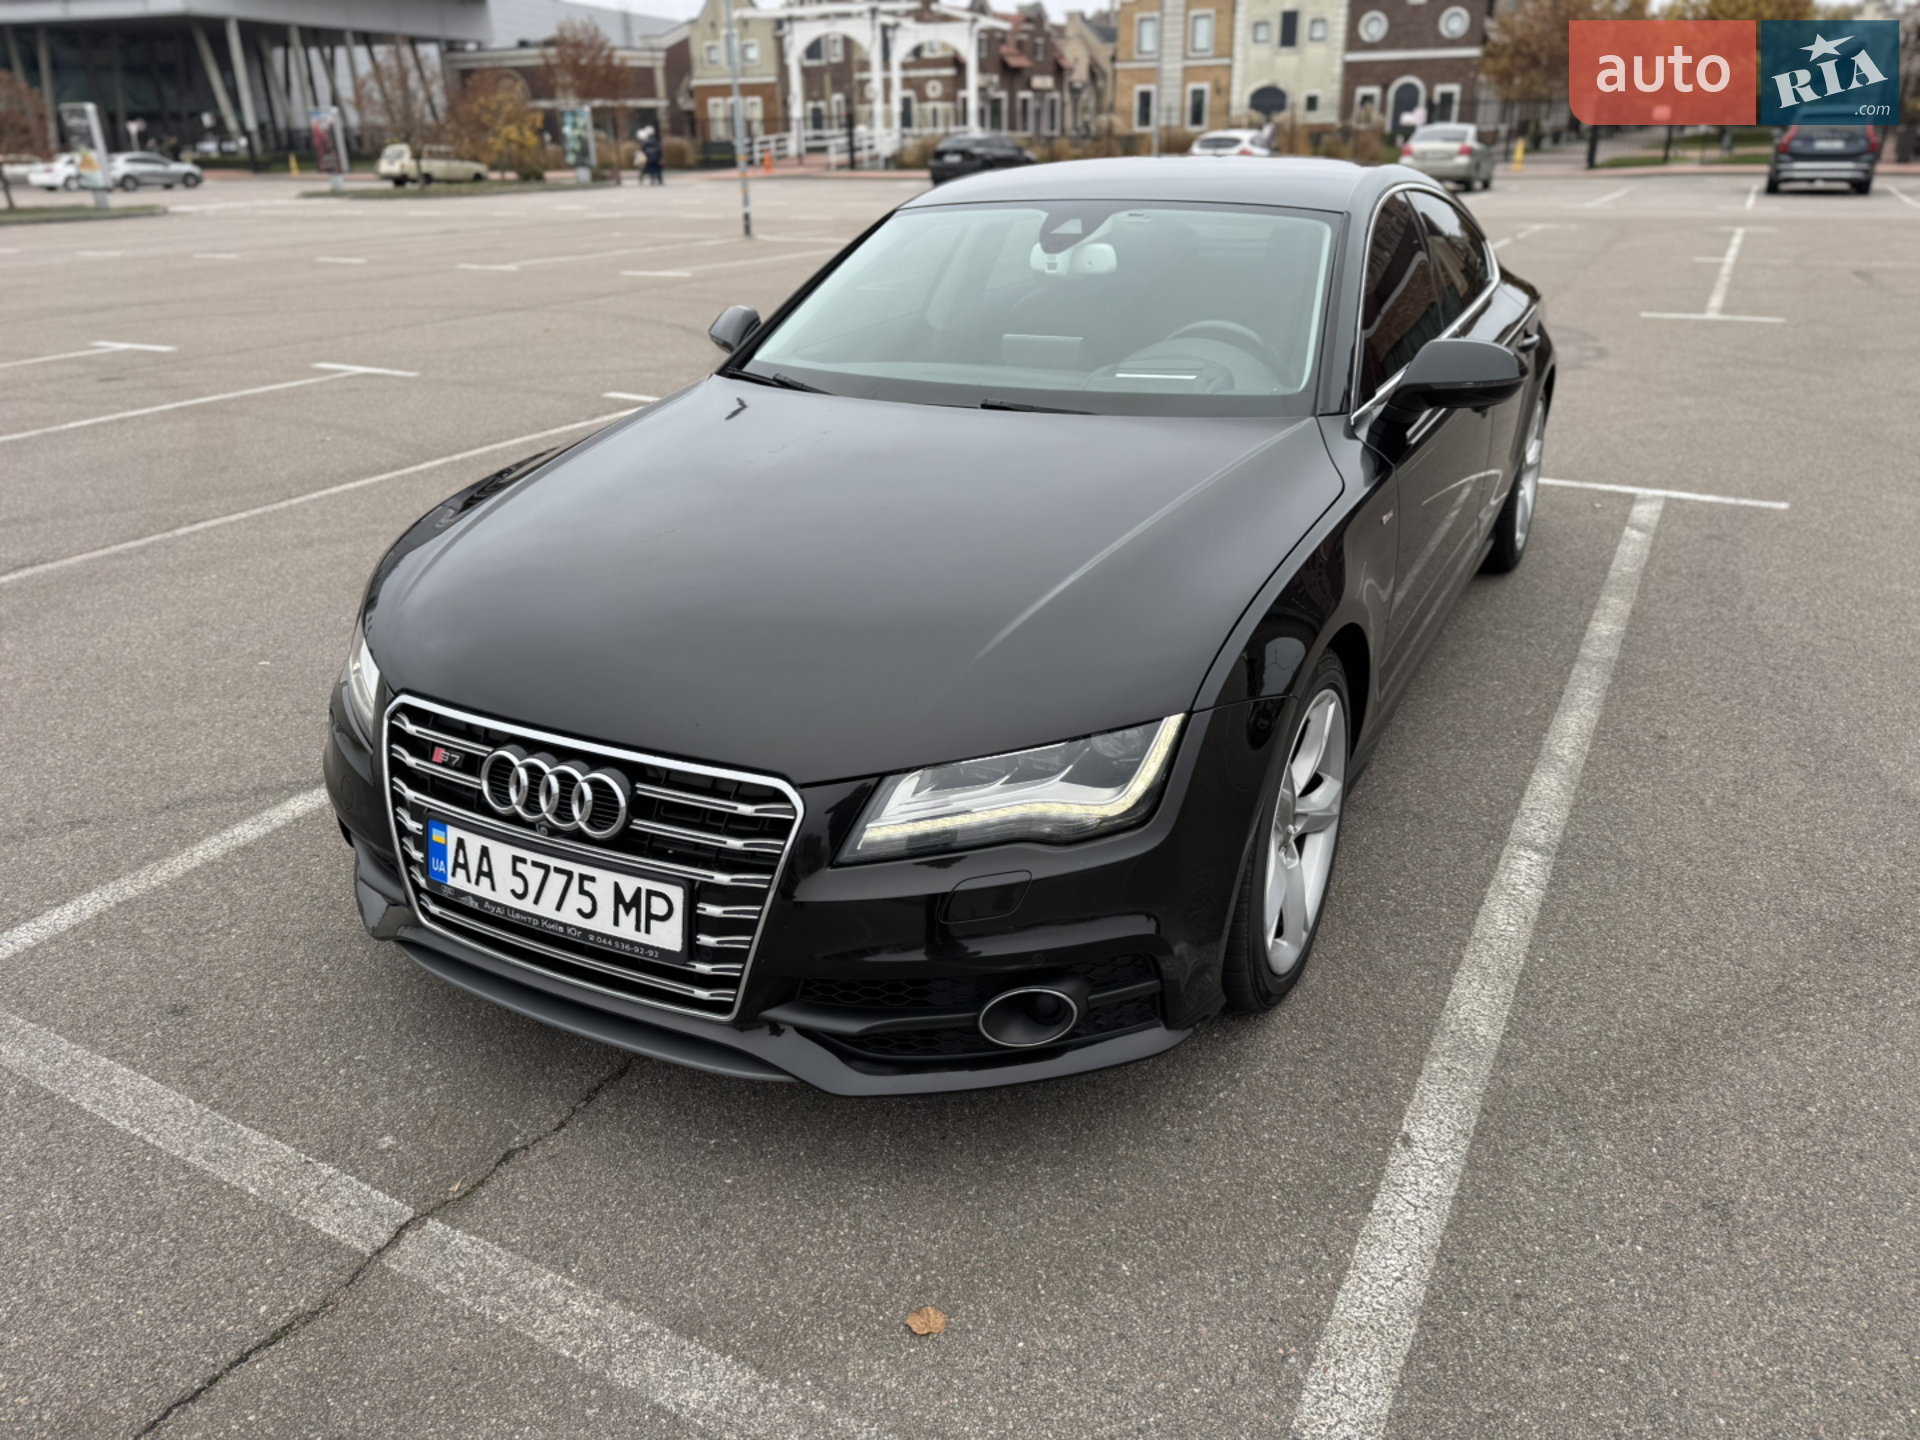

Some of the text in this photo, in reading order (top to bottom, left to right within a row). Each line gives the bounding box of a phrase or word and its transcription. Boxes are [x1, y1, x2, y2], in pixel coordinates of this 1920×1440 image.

[431, 856, 447, 874] UA
[451, 836, 674, 935] AA 5775 MP
[483, 900, 505, 914] Ауді
[507, 909, 538, 926] Центр
[541, 919, 564, 933] Київ
[566, 926, 583, 938] Юг
[596, 936, 612, 946] 044
[614, 942, 660, 958] 536-92-92
